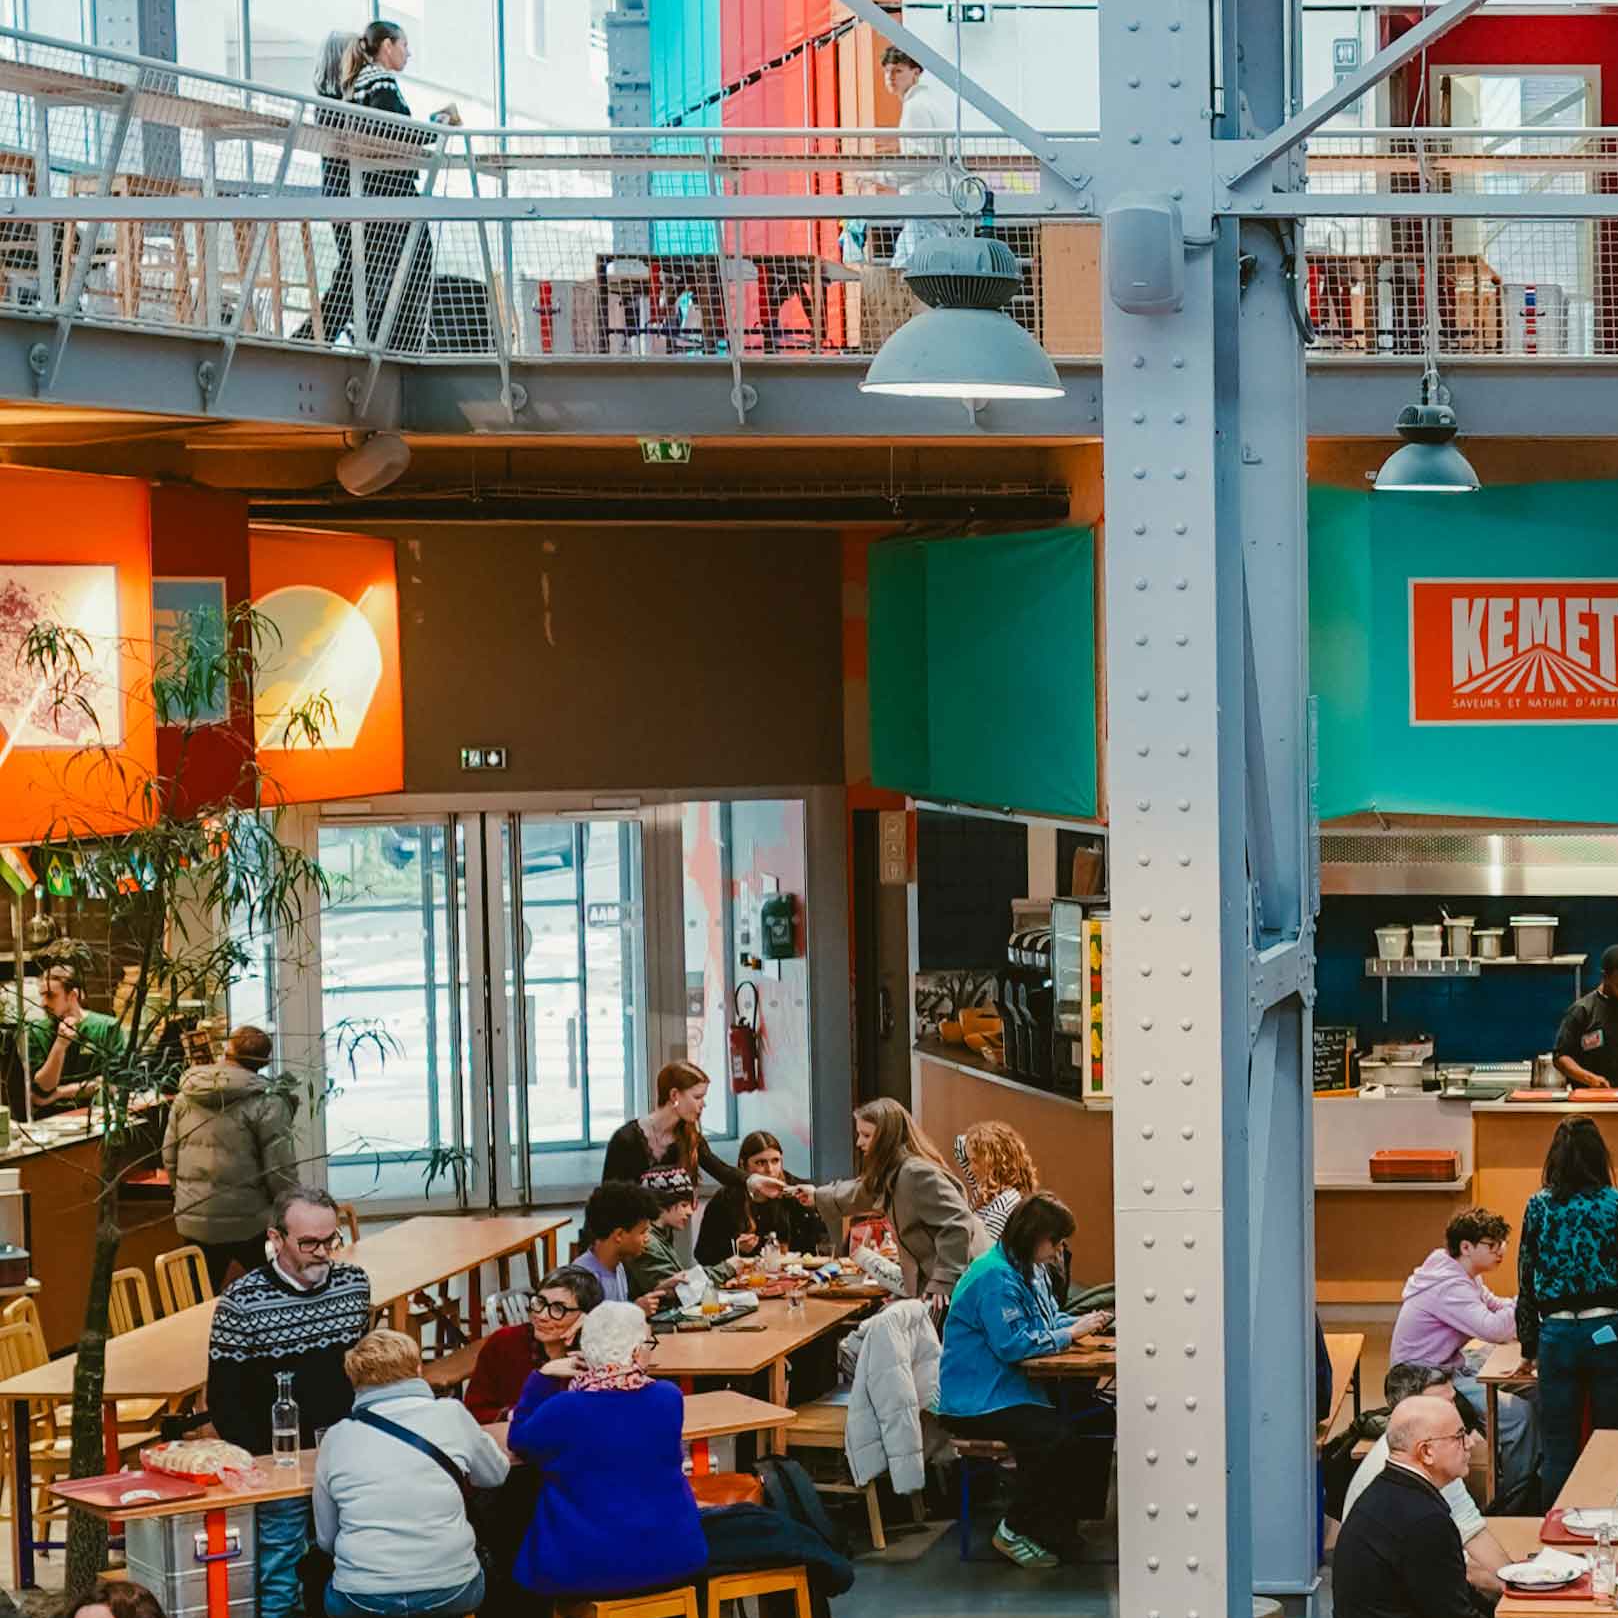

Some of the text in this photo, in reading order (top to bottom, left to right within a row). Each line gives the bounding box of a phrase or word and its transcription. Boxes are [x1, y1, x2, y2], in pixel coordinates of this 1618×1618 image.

[1452, 698, 1501, 709] SAVEURS
[1508, 698, 1521, 709] ET
[1528, 697, 1569, 709] NATURE
